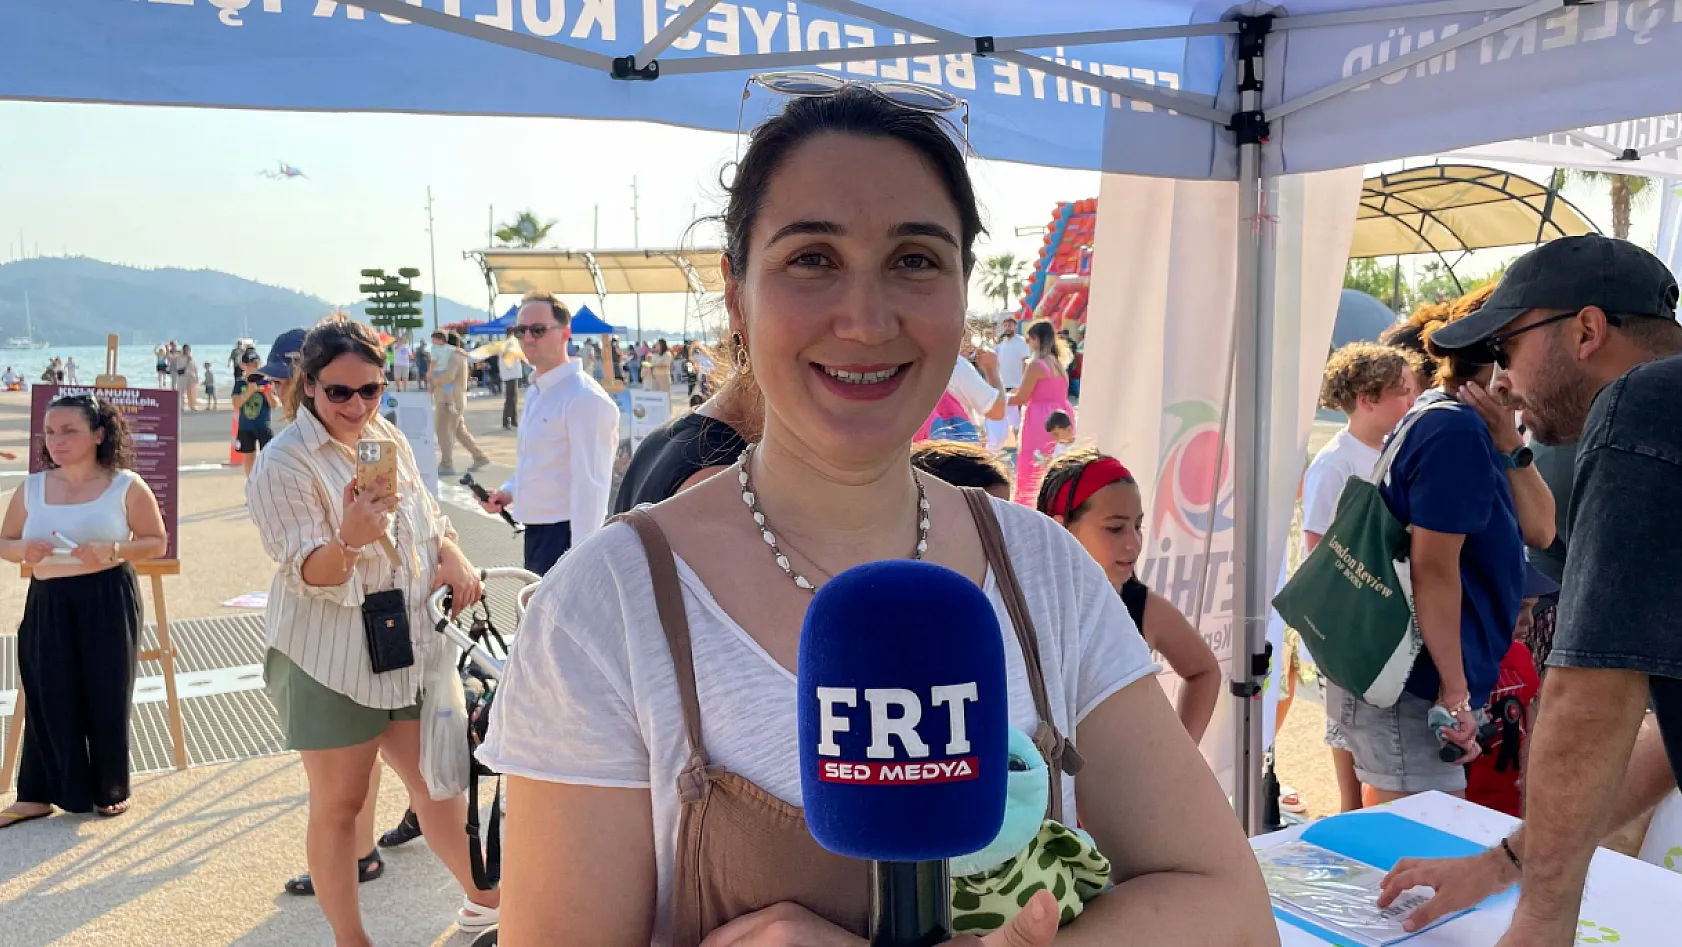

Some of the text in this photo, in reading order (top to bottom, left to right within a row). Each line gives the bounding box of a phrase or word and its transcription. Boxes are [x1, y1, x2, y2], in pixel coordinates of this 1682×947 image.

[1328, 534, 1393, 597] London Review
[816, 681, 979, 759] FRT
[824, 760, 972, 781] SED MEDYA
